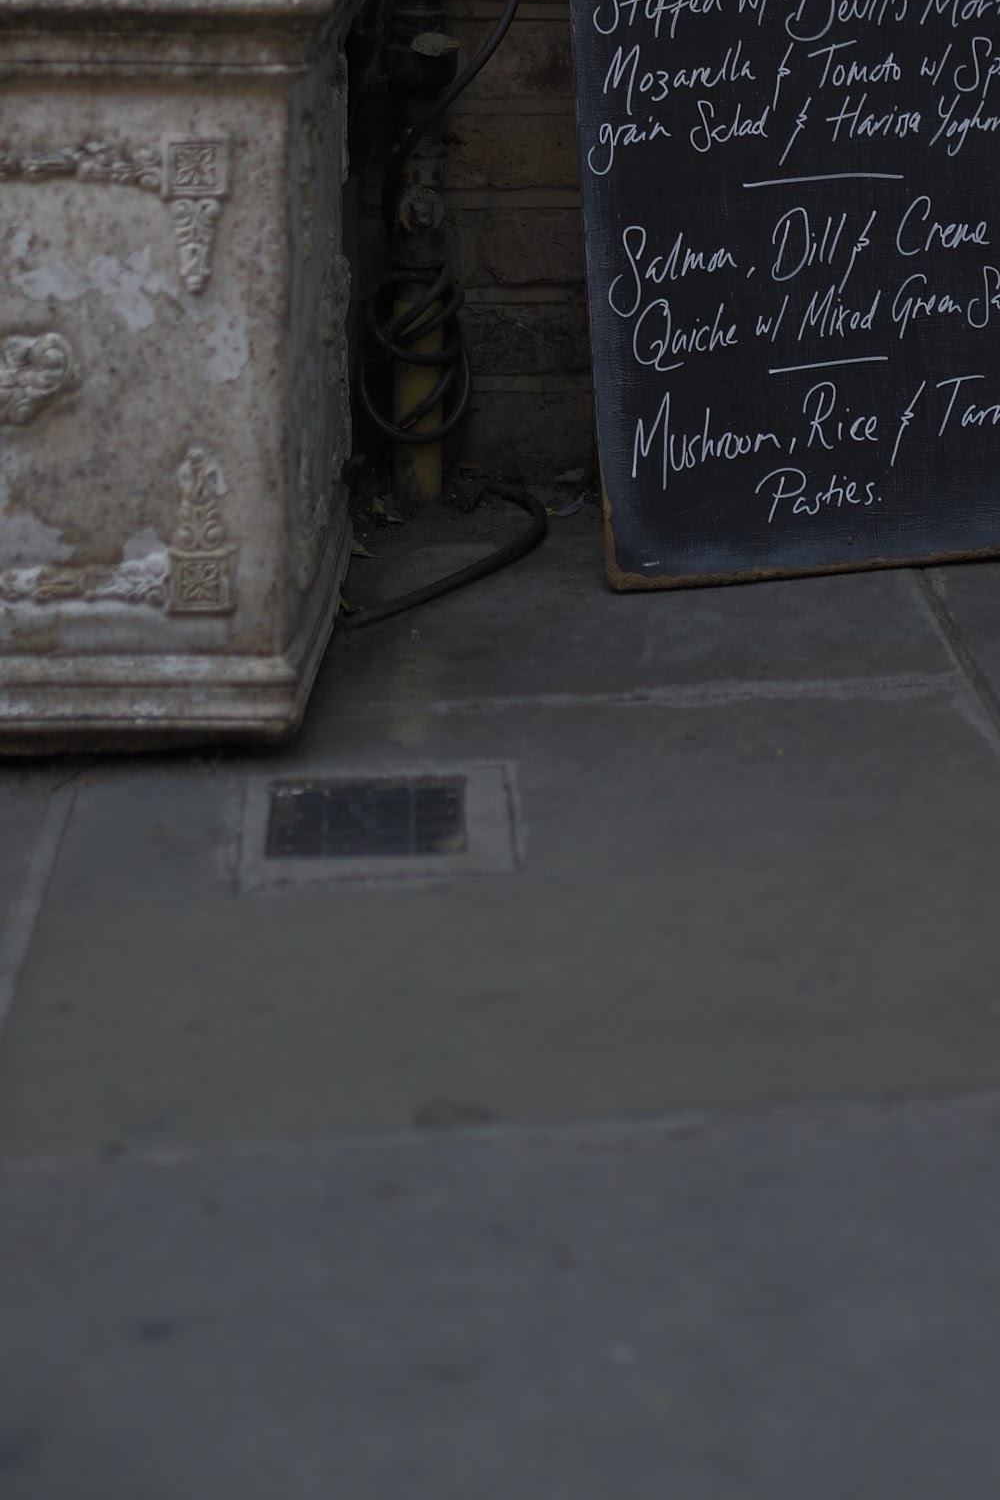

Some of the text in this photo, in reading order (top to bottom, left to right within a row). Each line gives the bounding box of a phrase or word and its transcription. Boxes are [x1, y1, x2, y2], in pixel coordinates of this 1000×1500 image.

[807, 39, 902, 89] Tomato
[587, 115, 673, 177] grain
[689, 99, 770, 153] Salad
[770, 206, 848, 282] Dill
[632, 297, 739, 373] Quiche
[796, 284, 881, 342] Mixed
[891, 272, 963, 340] Green
[631, 390, 796, 491] Mushroom,
[802, 380, 880, 451] Rice
[753, 466, 883, 524] Pasties.
